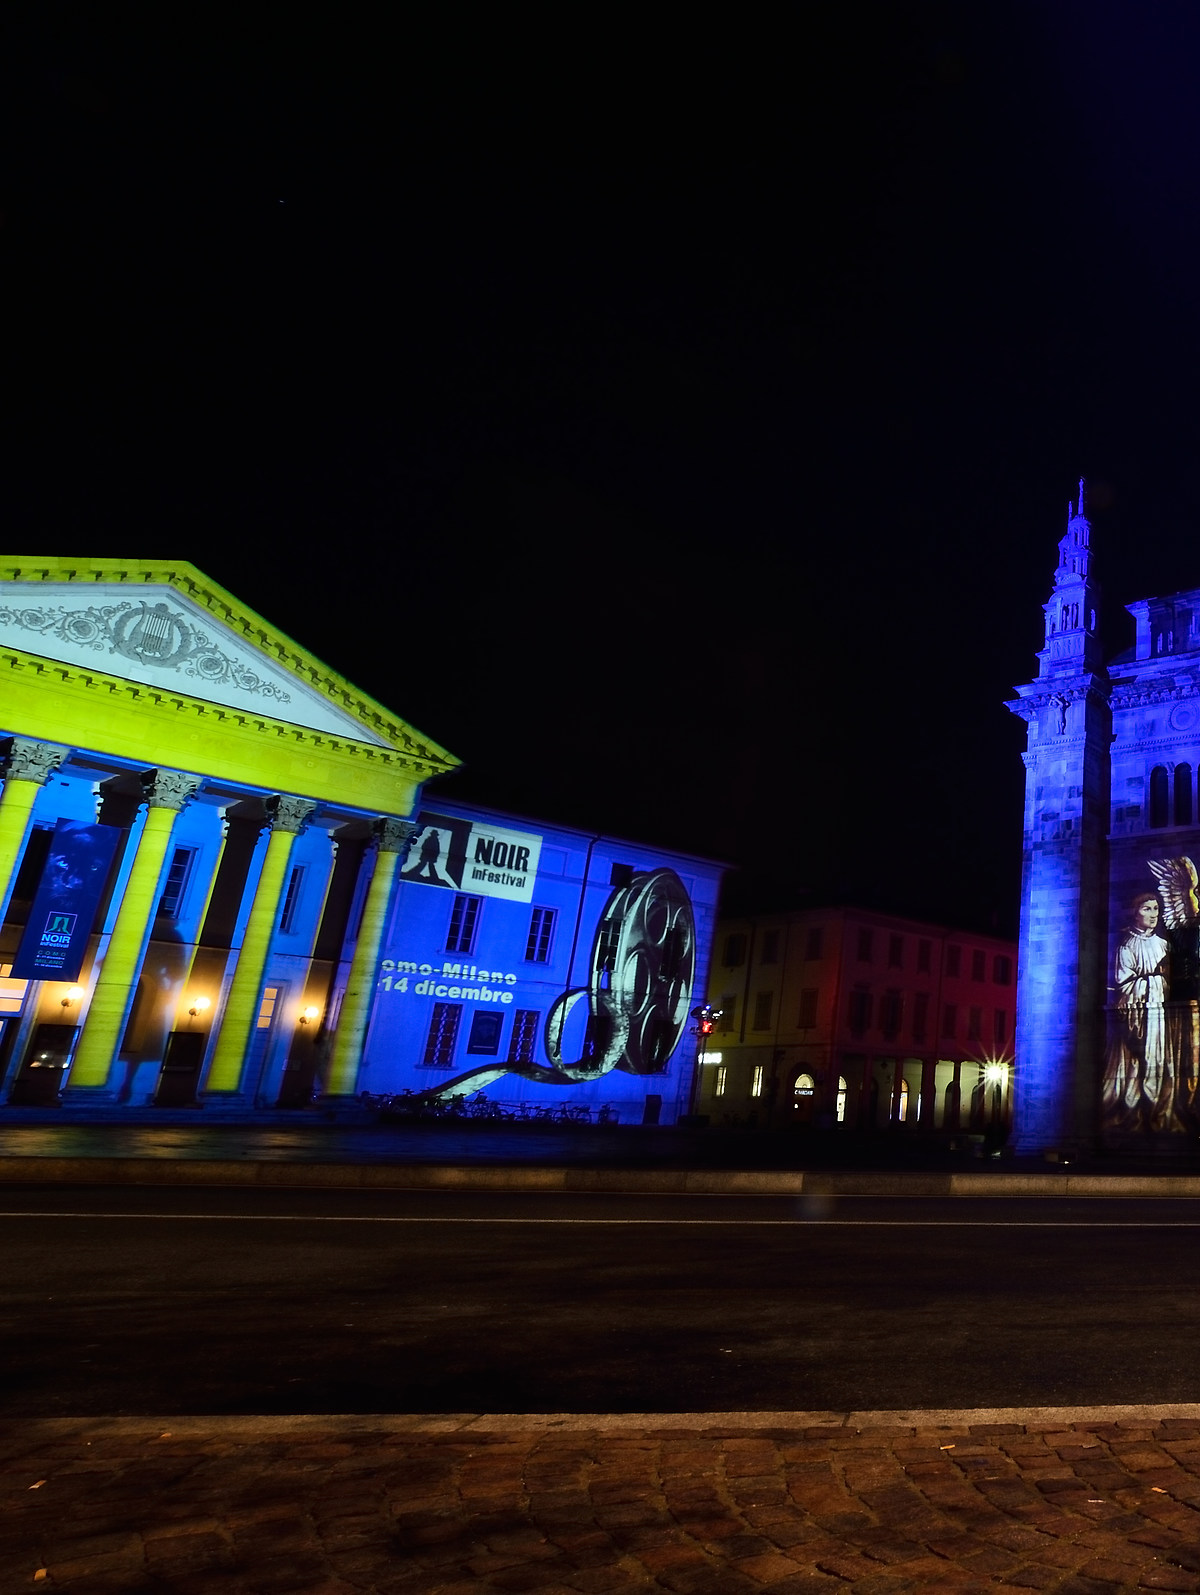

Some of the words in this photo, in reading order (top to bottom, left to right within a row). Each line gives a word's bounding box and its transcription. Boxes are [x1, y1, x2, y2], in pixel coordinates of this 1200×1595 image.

[474, 837, 530, 872] NOIR
[471, 867, 526, 888] inFestival
[41, 934, 70, 943] NOIR
[381, 959, 517, 985] omo-Milano
[414, 980, 514, 1004] dicembre
